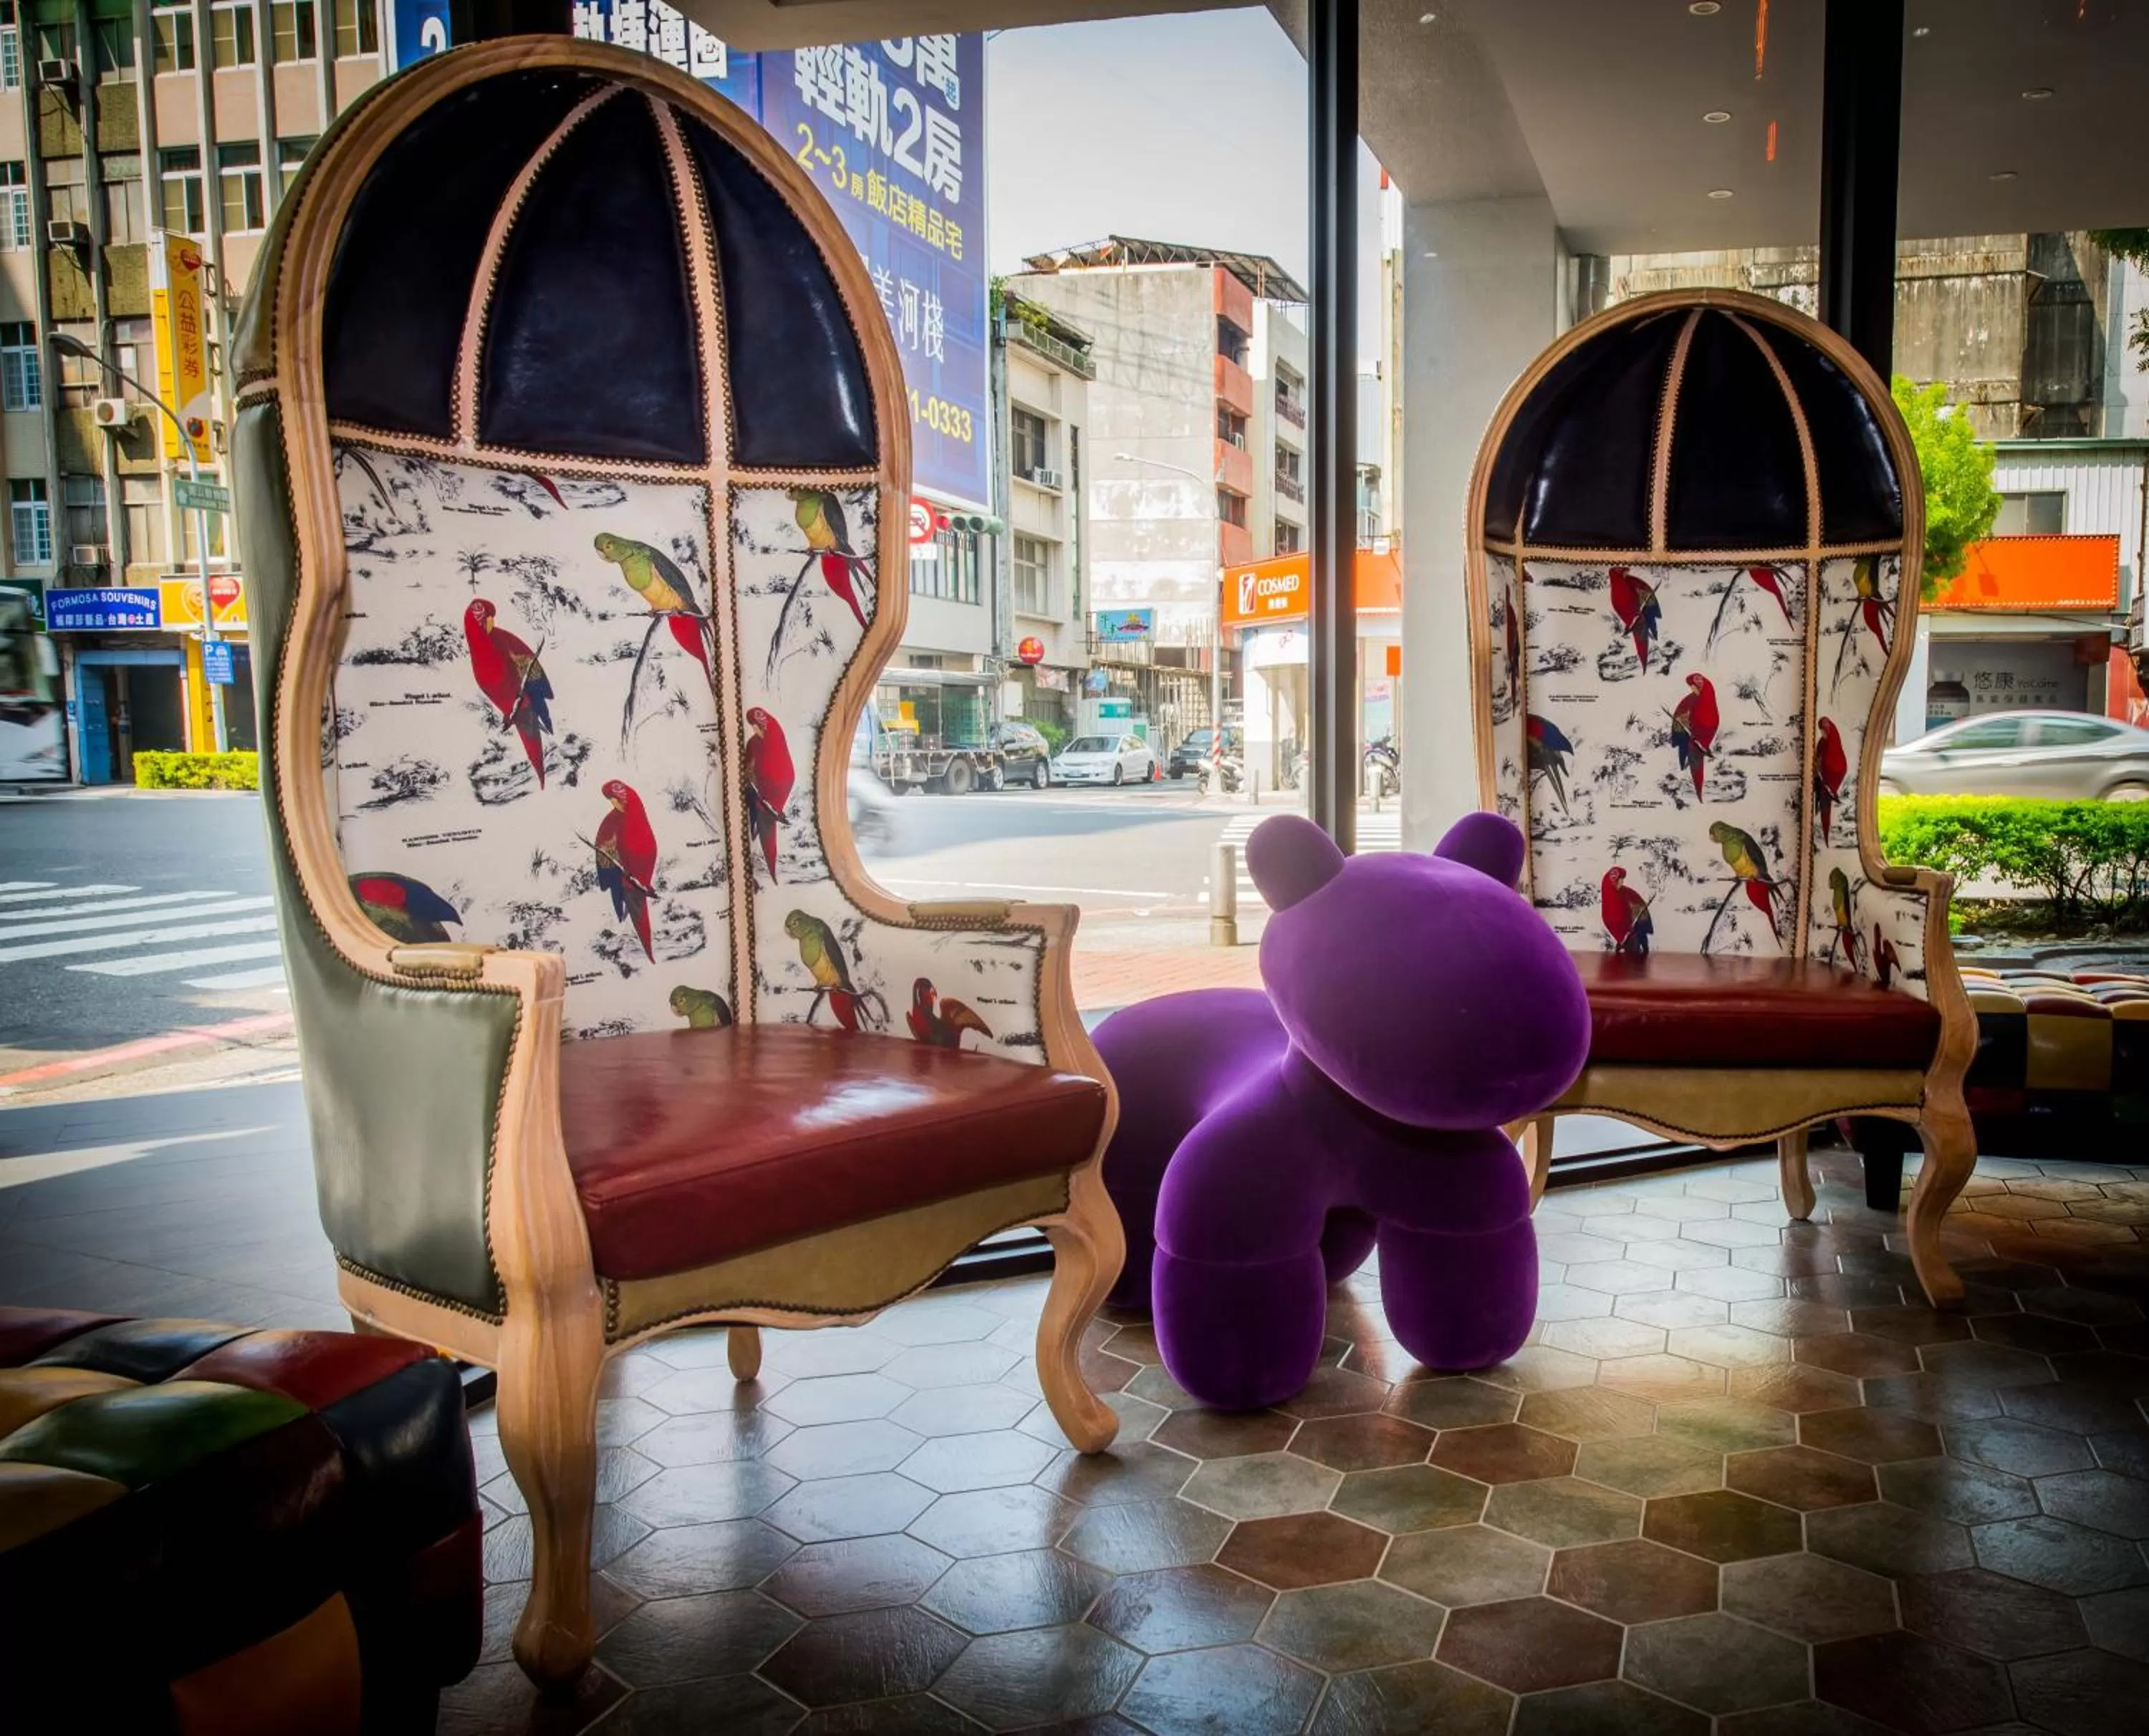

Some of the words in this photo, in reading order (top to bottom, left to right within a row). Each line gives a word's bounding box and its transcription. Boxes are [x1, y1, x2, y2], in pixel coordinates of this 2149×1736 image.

[905, 384, 972, 443] 1-0333
[1258, 574, 1299, 596] COSMED
[51, 594, 100, 611] FORMOSA
[100, 592, 157, 610] SOUVENIRS
[205, 645, 213, 657] P
